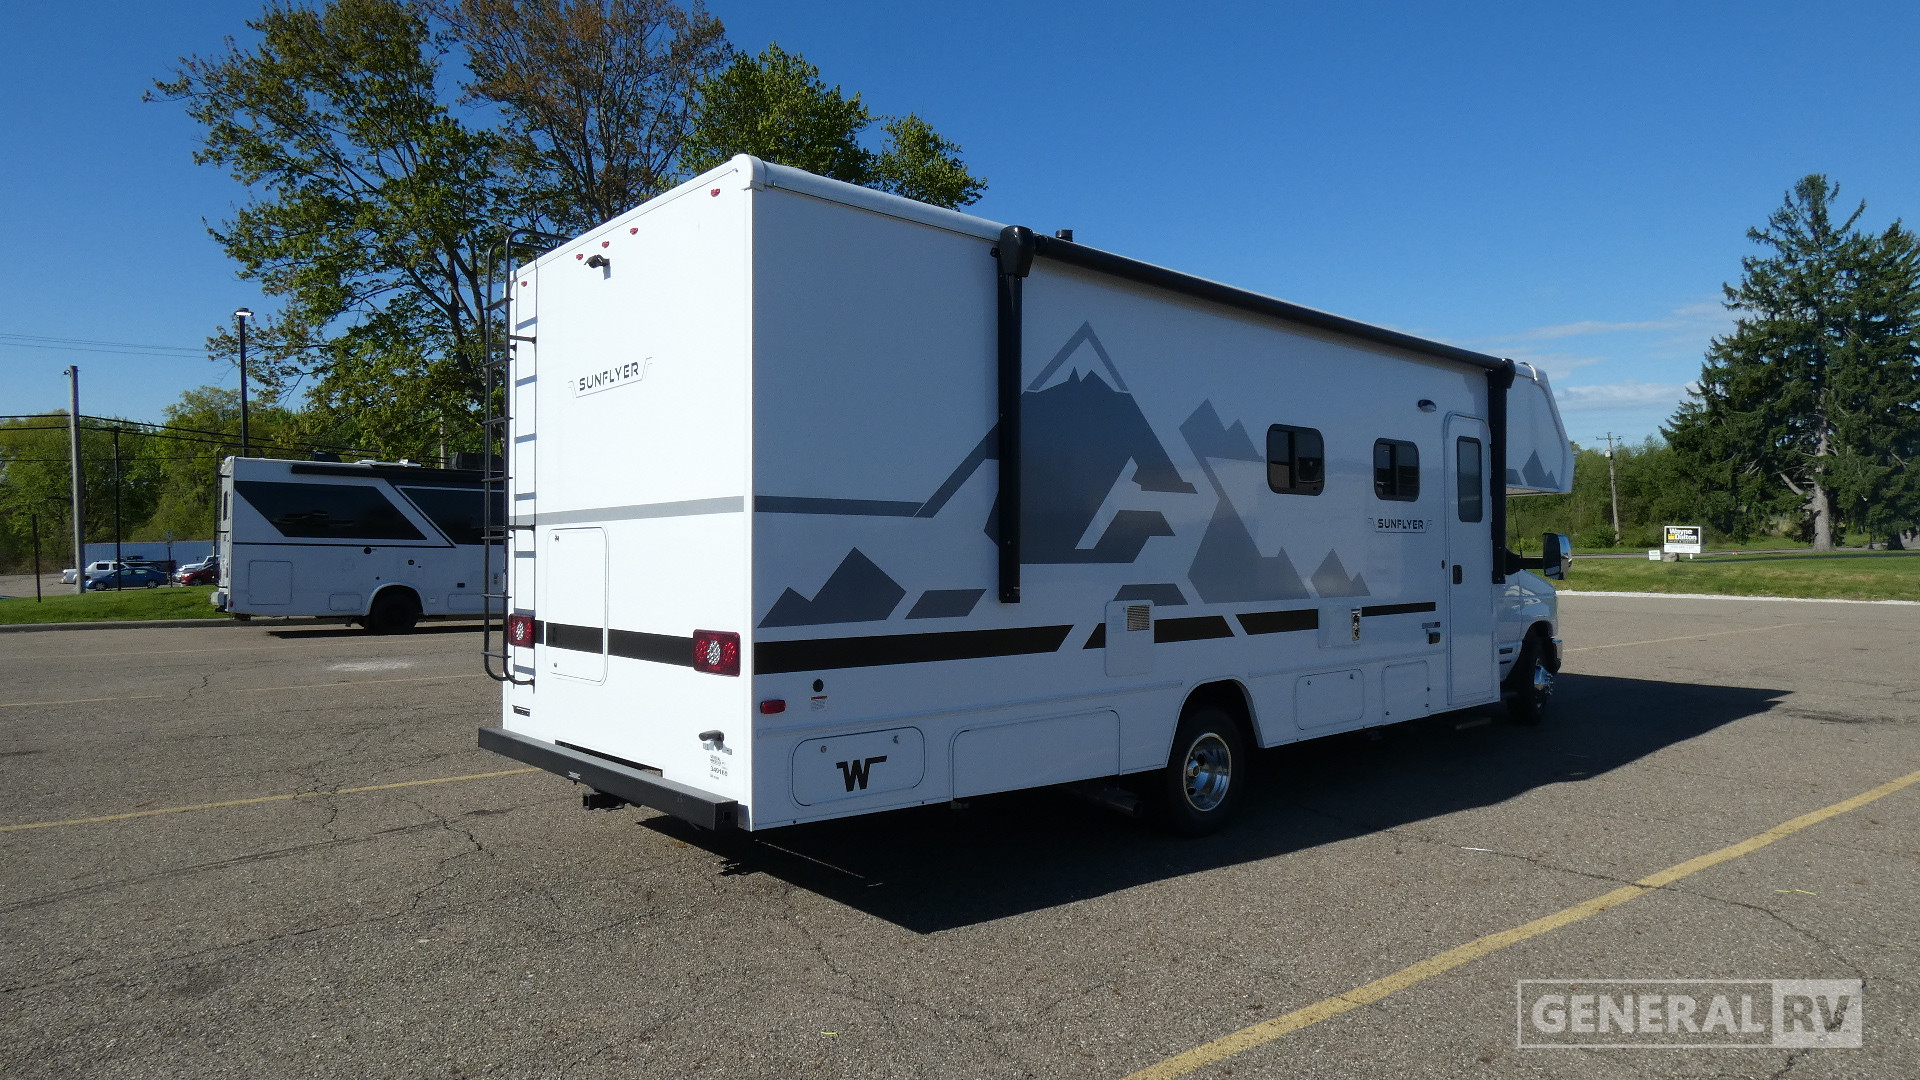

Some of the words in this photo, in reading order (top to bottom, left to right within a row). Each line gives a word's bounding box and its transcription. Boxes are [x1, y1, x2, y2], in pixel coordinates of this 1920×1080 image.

[579, 361, 639, 391] SUNFLYER
[1377, 518, 1424, 530] SUNFLYER
[1669, 528, 1693, 536] Wayne
[1674, 533, 1698, 541] Dalton
